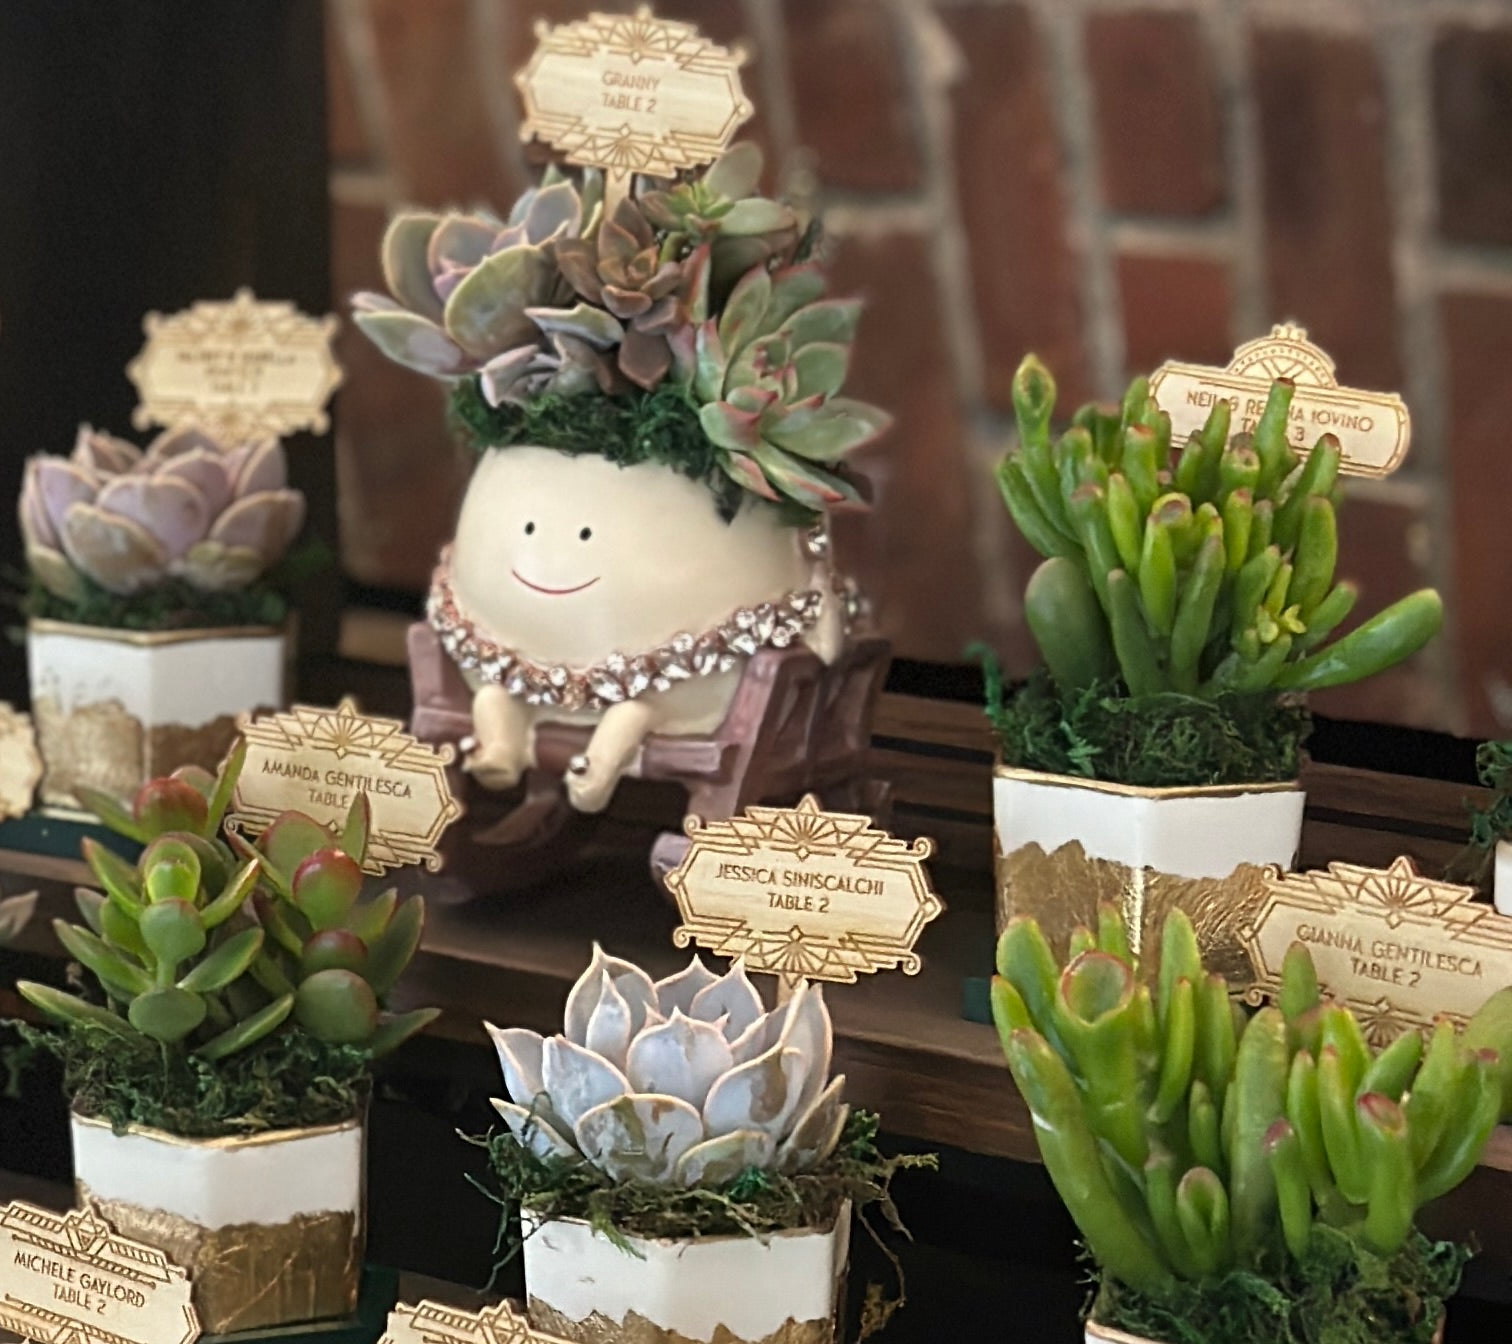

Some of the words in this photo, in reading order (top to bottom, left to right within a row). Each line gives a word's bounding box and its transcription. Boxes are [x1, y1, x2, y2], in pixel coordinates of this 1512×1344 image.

[601, 70, 661, 90] GRANNY
[600, 93, 644, 113] TABLE
[646, 98, 658, 114] 2
[1294, 427, 1306, 443] 3
[1311, 409, 1374, 433] IOVINO
[262, 759, 320, 785] AMANDA
[325, 769, 412, 800] GENTILESCA
[308, 787, 349, 809] TABLE
[715, 862, 777, 886] JESSICA
[783, 870, 885, 896] SINISCALCHI
[767, 892, 814, 913] TABLE
[819, 897, 830, 914] 2
[1295, 923, 1365, 954] GIANNA
[1372, 940, 1484, 978] GENTILESCA
[1351, 956, 1405, 986] TABLE
[1408, 971, 1423, 989] 2
[13, 1250, 76, 1283] MICHELE
[79, 1272, 145, 1309] GAYLORD
[52, 1282, 92, 1312] TABLE
[96, 1299, 108, 1316] 2
